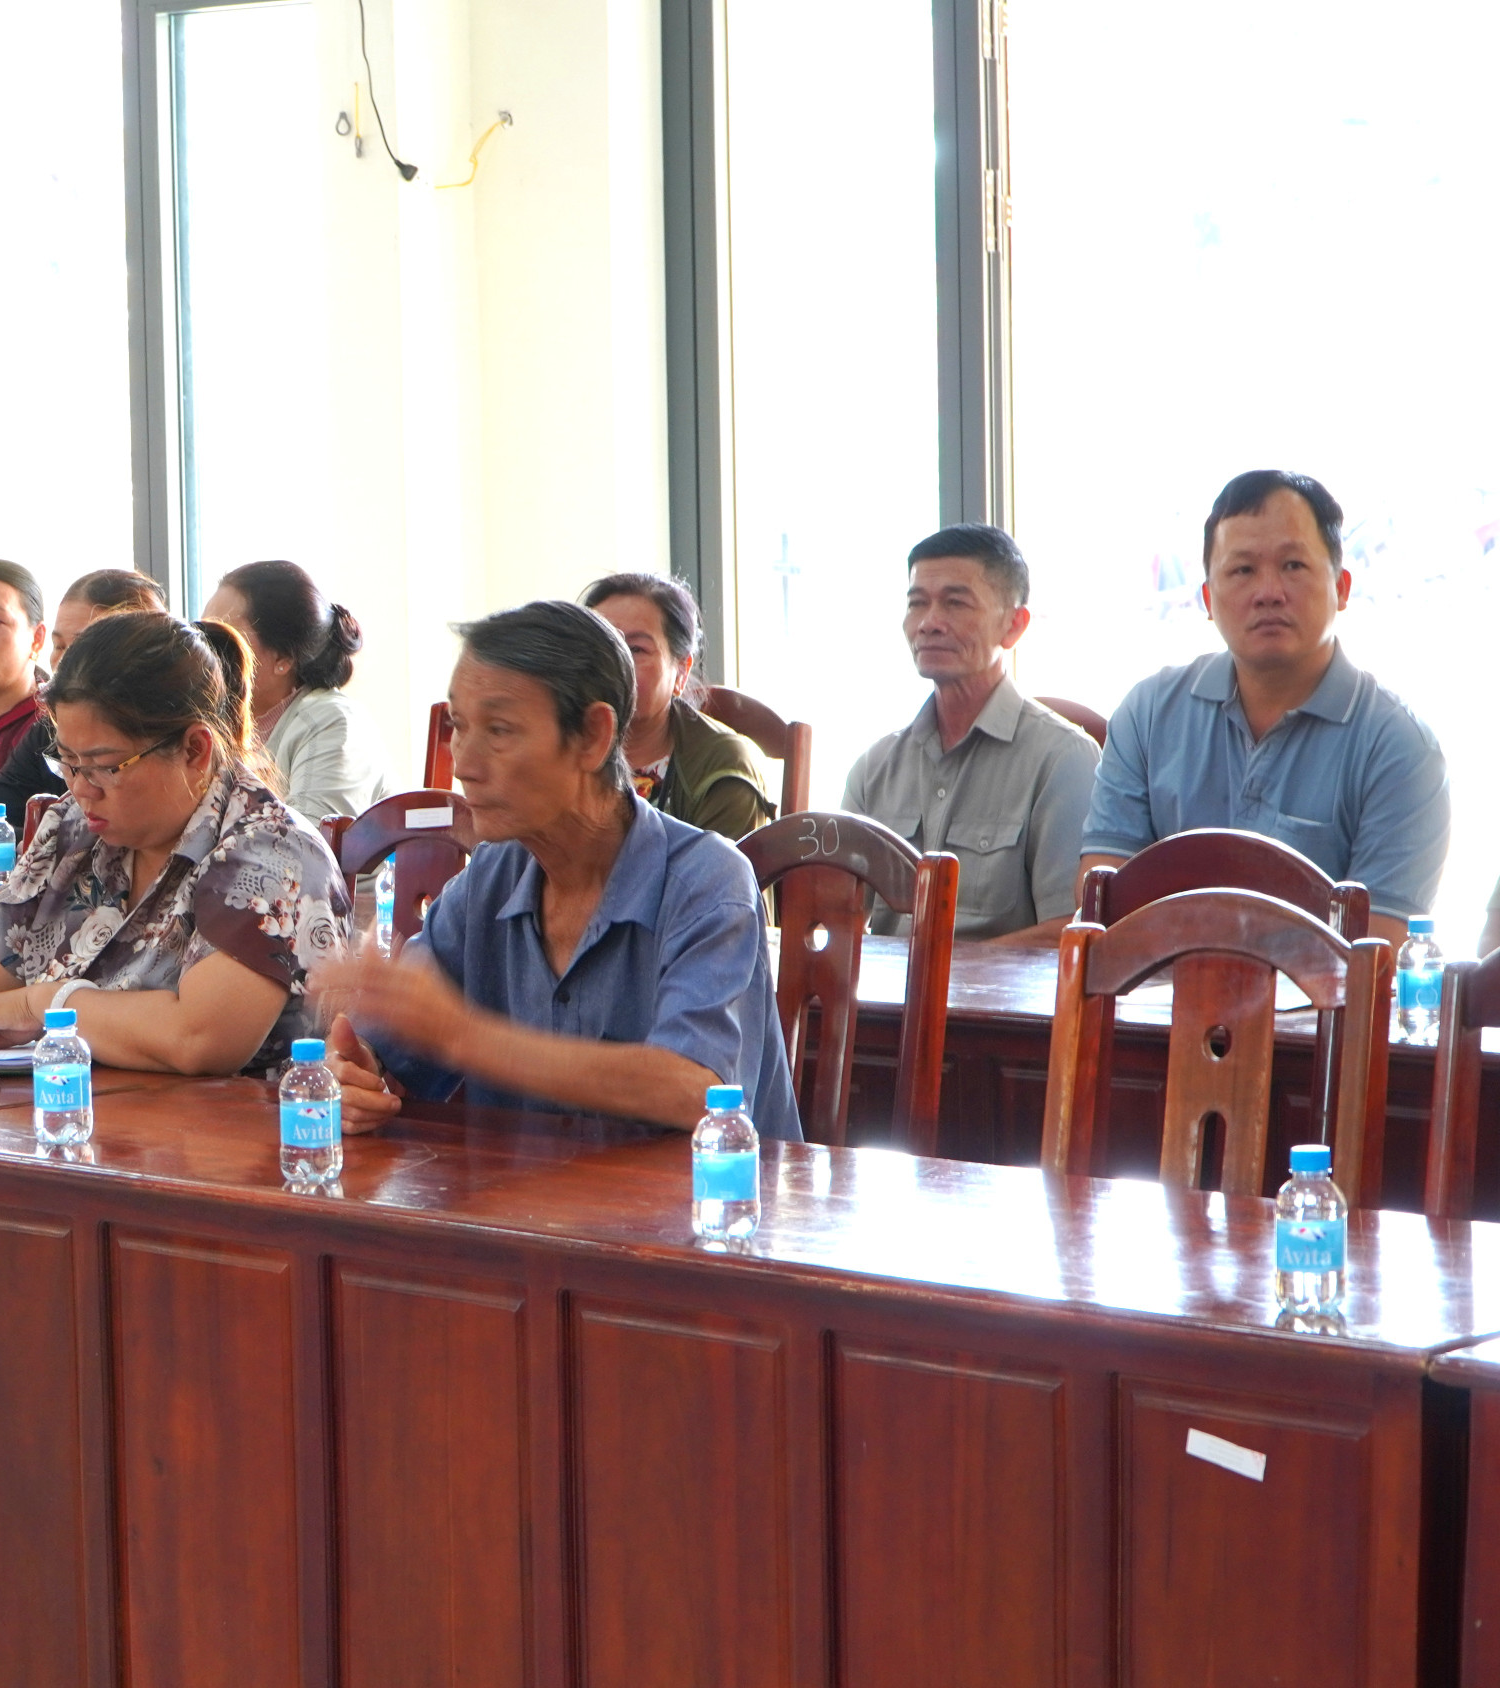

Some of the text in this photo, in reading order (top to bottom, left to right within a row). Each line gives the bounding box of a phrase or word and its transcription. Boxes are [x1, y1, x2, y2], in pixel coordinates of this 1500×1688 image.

[799, 818, 840, 860] 30
[39, 1088, 75, 1105] Avita
[293, 1123, 332, 1140] Avita
[1282, 1245, 1332, 1266] Avita
